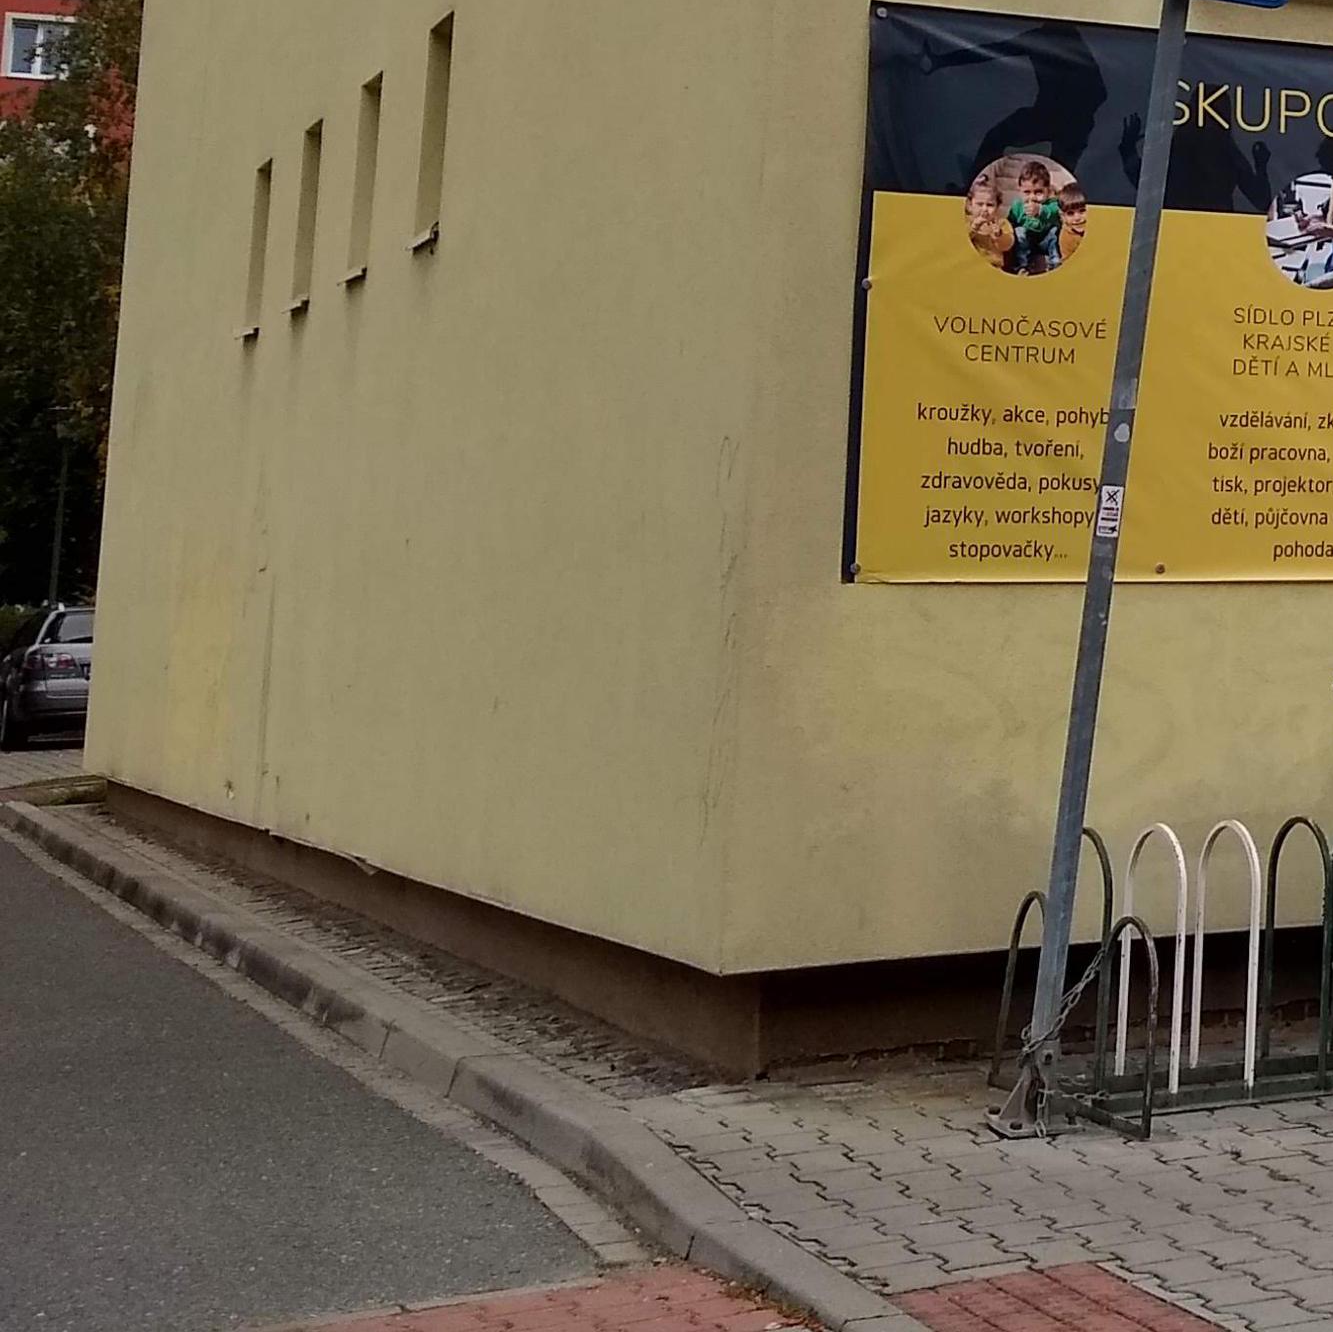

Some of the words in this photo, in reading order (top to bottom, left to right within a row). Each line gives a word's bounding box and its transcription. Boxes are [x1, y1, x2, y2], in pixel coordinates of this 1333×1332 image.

[1233, 304, 1295, 326] SÍDLO
[933, 315, 1107, 339] VOLNOČASOVÉ
[1242, 332, 1330, 353] KRAJSKÉ
[965, 344, 1075, 364] CENTRUM
[1232, 355, 1280, 377] DĚTÍ
[1285, 361, 1300, 377] A
[917, 402, 997, 426] kroužky,
[1002, 405, 1050, 426] akce,
[1219, 411, 1312, 432] vzdělávání,
[947, 437, 1009, 459] hudba,
[1014, 440, 1085, 460] tvoření,
[1208, 442, 1244, 460] boží
[1249, 446, 1331, 465] pracovna,
[920, 471, 1032, 493] zdravověda,
[1212, 476, 1248, 495] tisk,
[923, 506, 988, 528] jazyky,
[1211, 508, 1249, 527] dětí,
[1254, 508, 1329, 529] půjčovna
